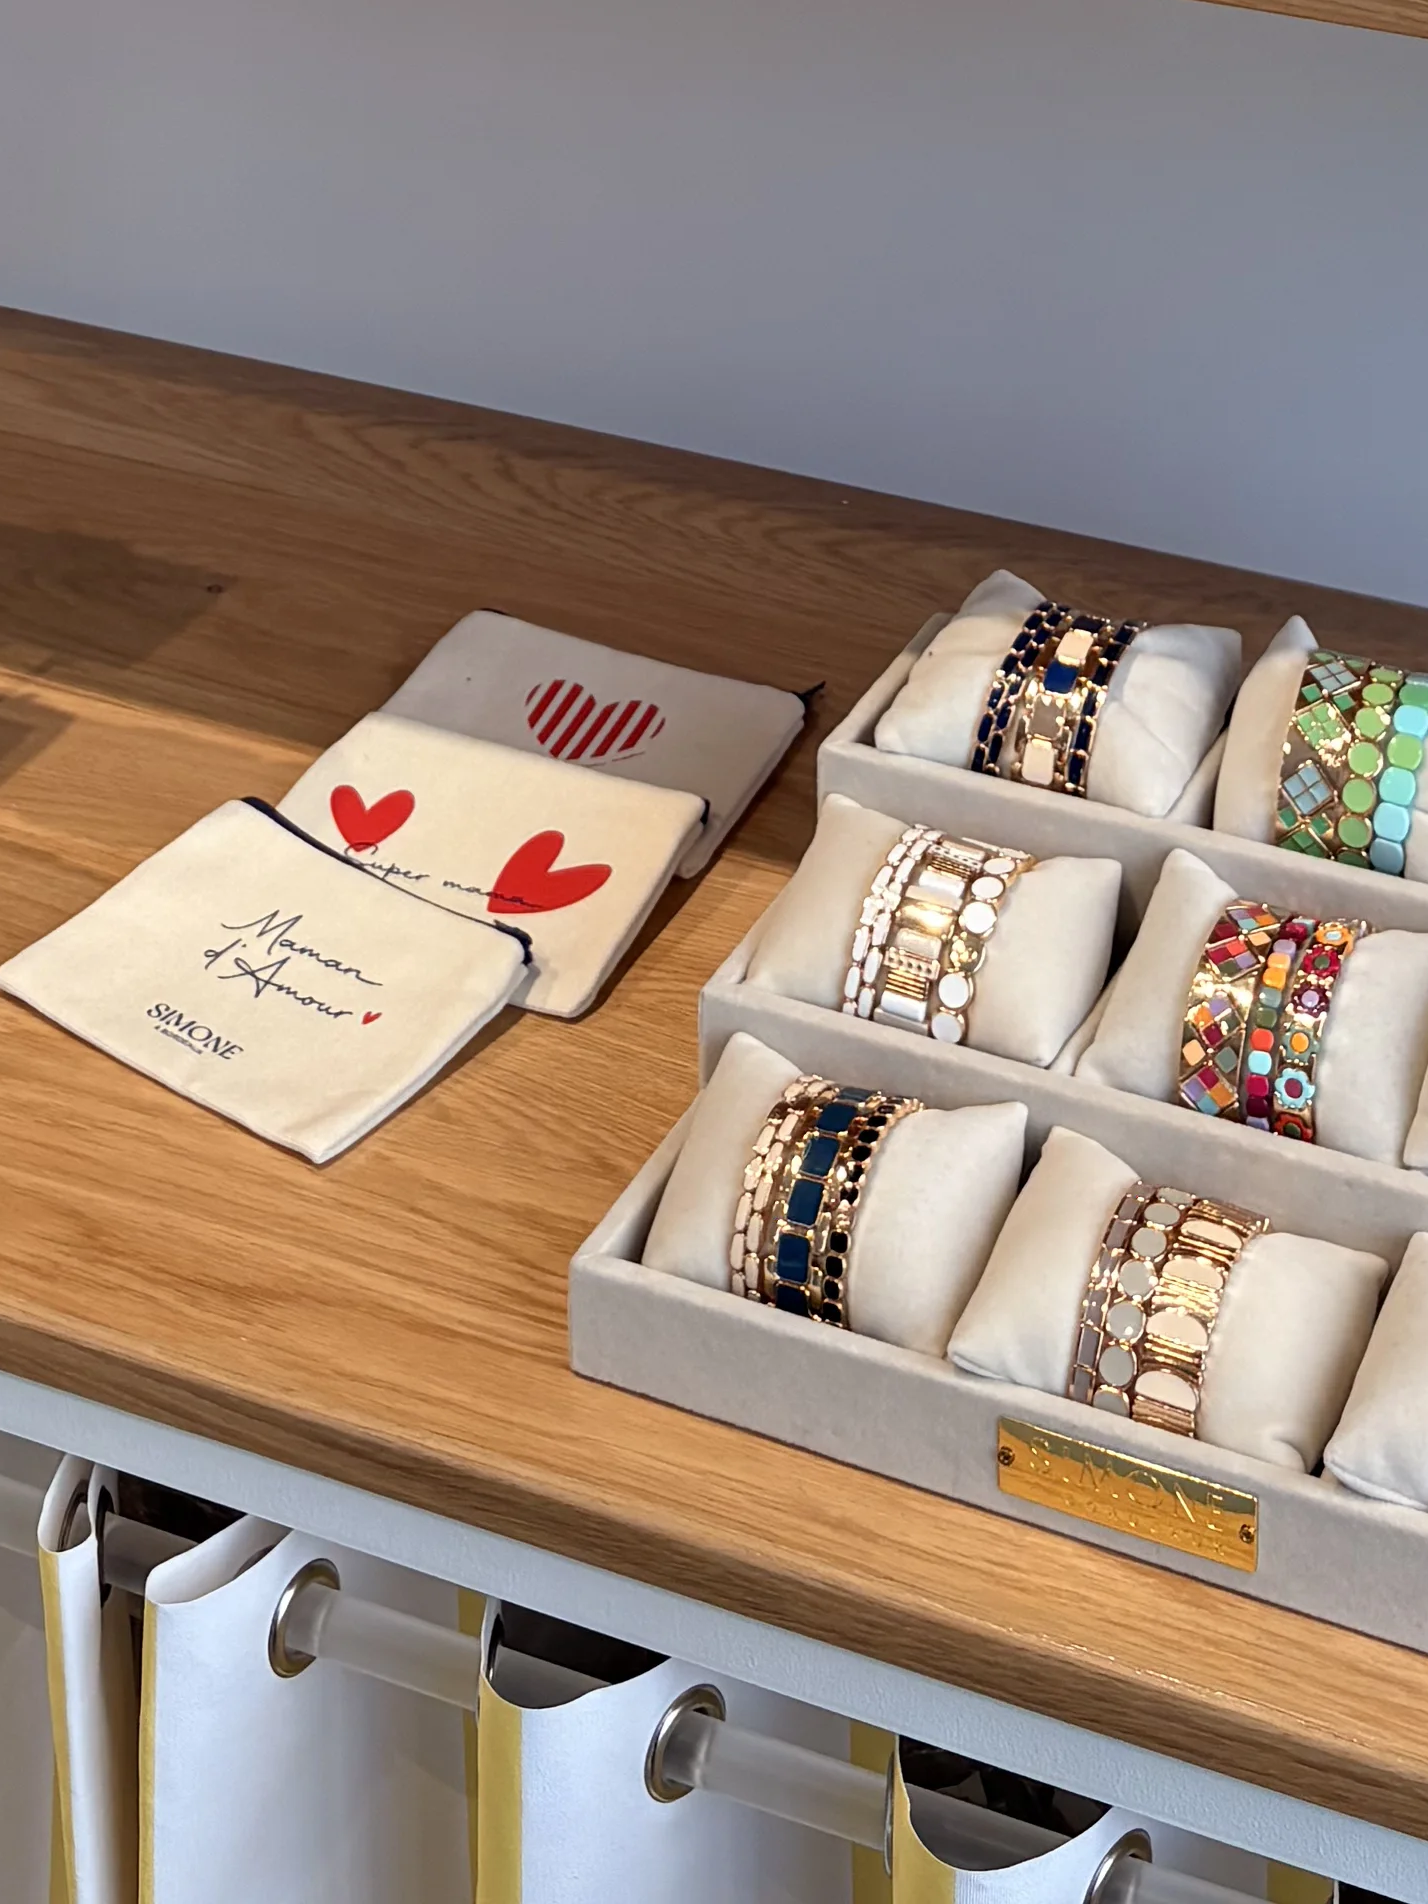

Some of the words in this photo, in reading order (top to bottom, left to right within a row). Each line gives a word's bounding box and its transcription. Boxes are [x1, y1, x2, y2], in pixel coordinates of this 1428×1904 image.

[221, 909, 383, 987] Maman
[146, 1002, 244, 1061] SIMONE
[1030, 1436, 1224, 1533] SIMONE
